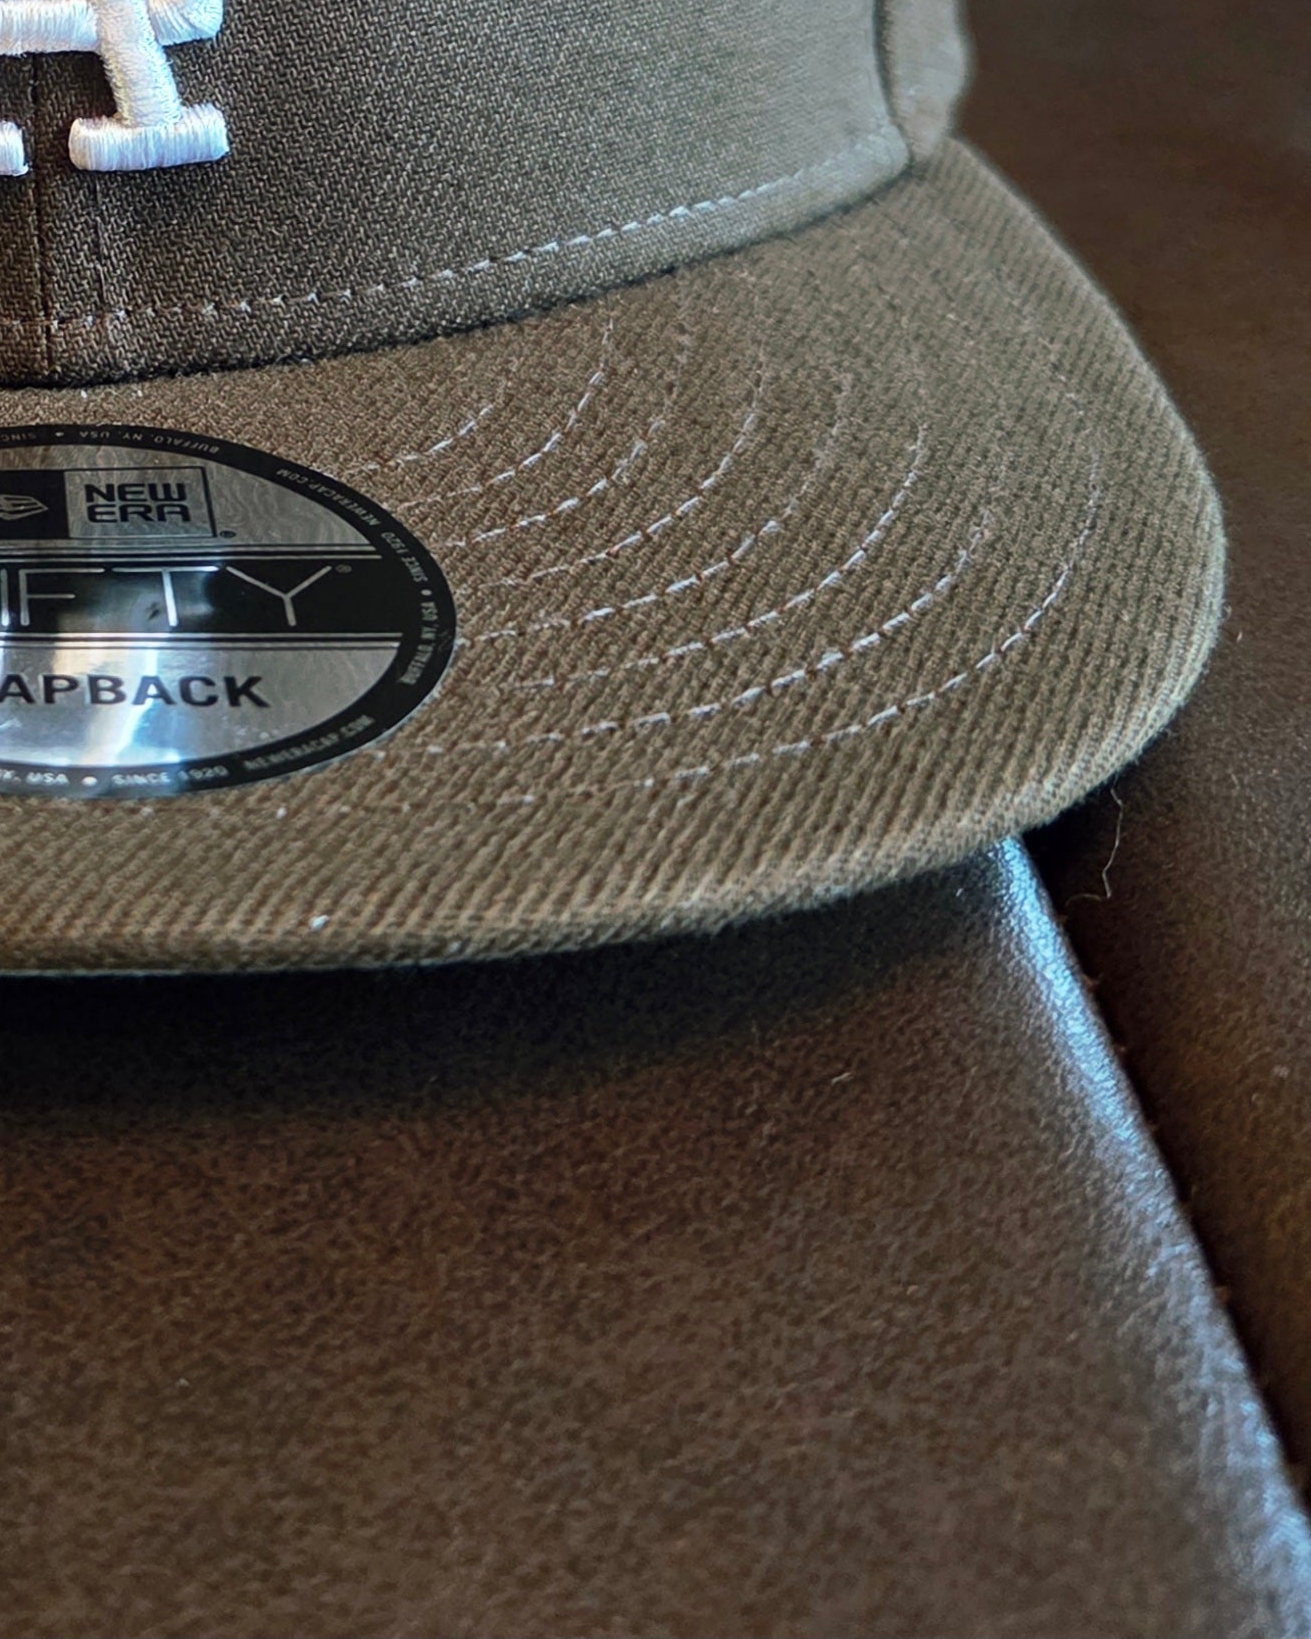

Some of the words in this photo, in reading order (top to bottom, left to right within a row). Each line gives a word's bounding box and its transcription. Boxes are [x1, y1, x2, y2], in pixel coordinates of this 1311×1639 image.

[79, 430, 110, 440] USA
[85, 482, 188, 503] NEW
[275, 467, 382, 527] NEWERACAP.COM
[89, 504, 191, 523] ERA
[26, 771, 70, 787] USA
[111, 771, 173, 787] SINCE
[176, 765, 230, 781] 1920
